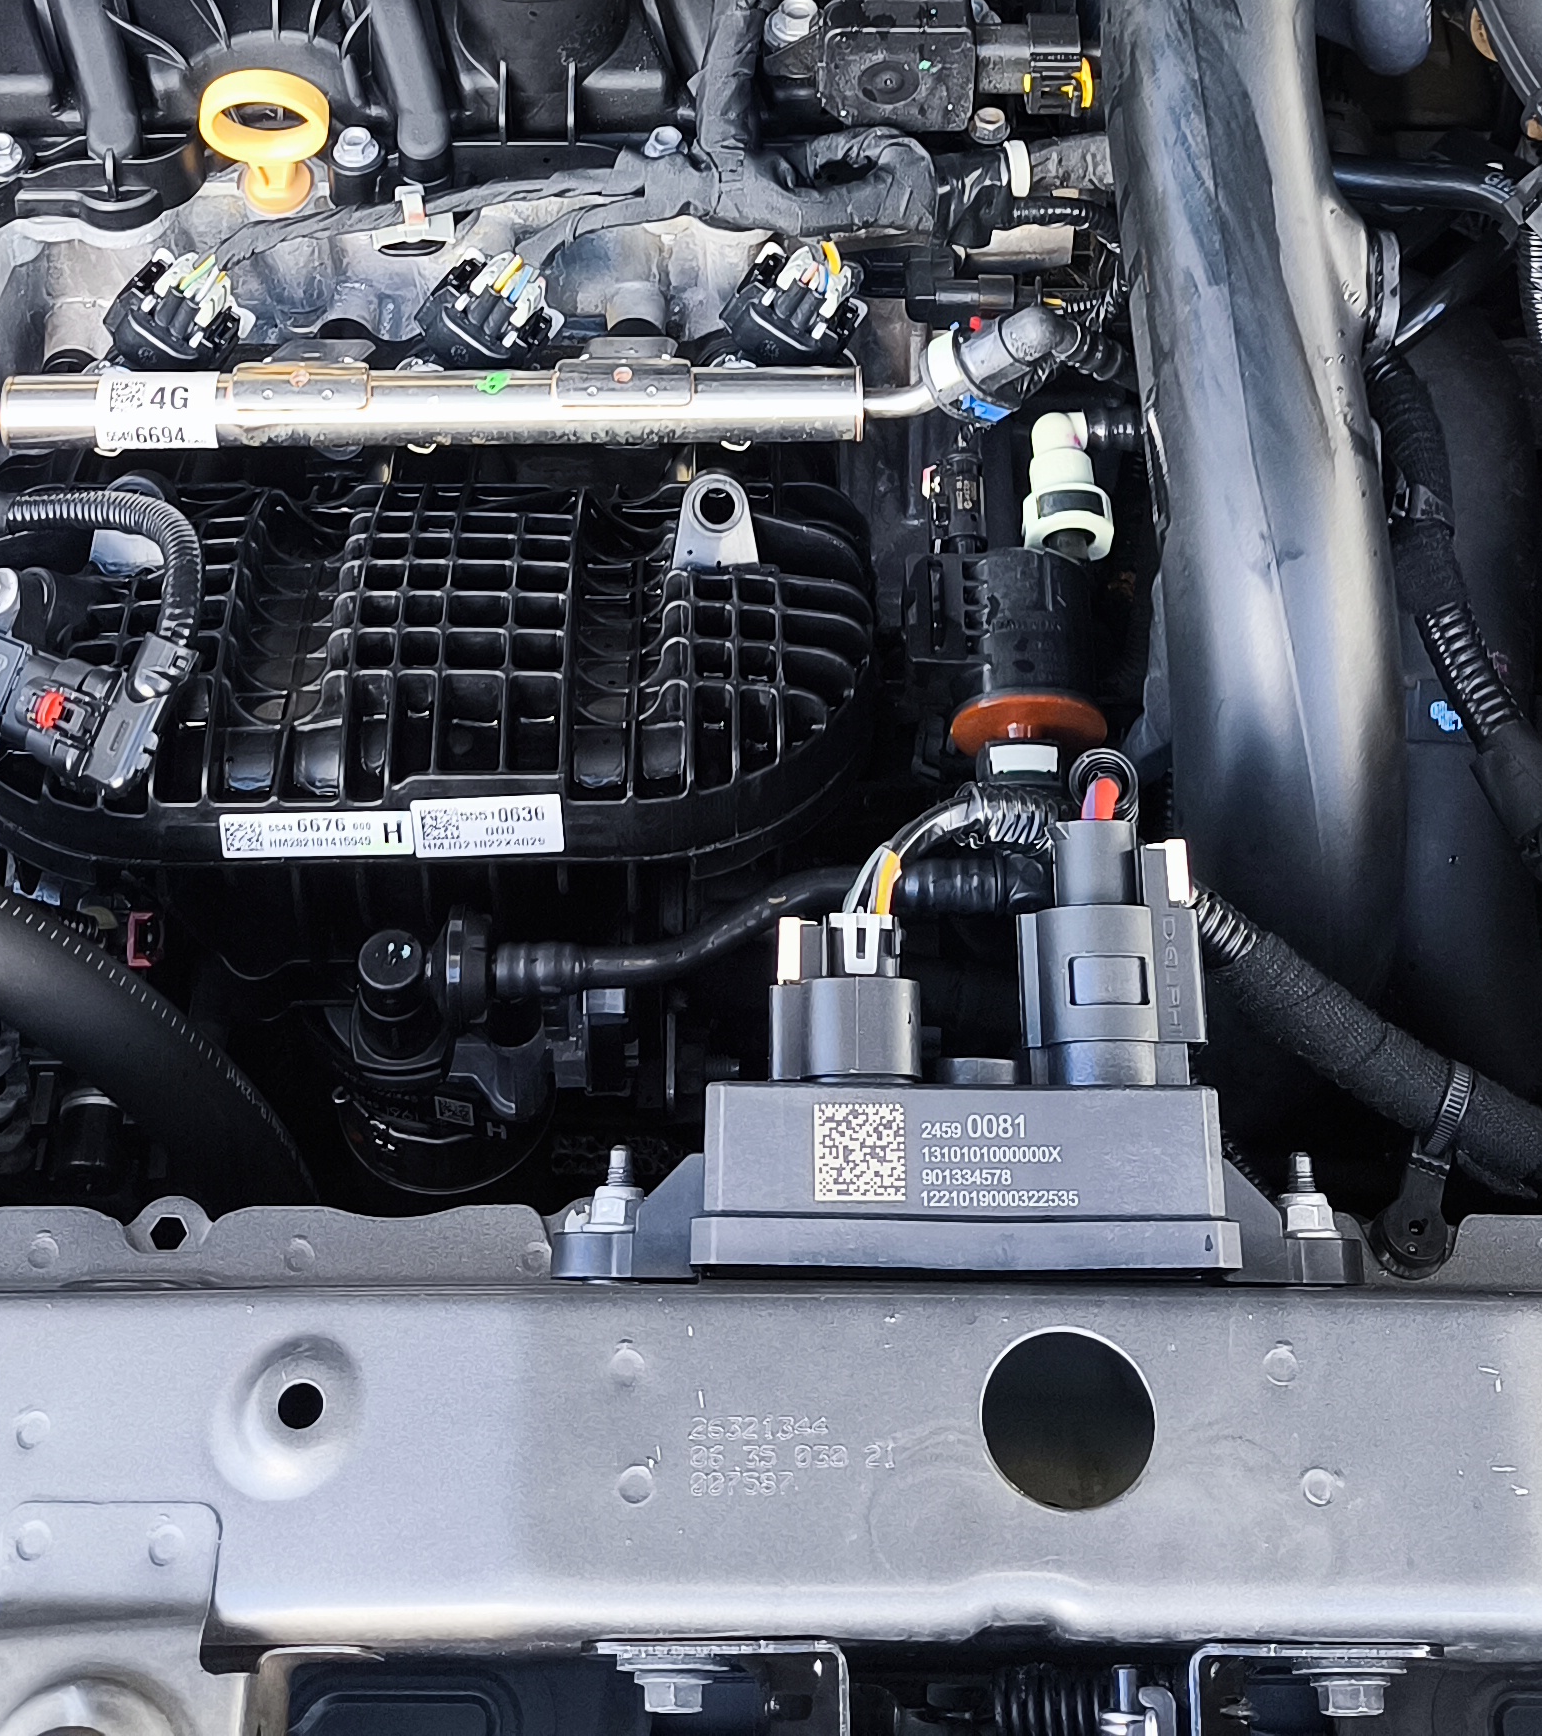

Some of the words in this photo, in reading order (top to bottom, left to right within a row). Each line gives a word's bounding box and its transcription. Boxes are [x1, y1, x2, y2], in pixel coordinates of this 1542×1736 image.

[150, 386, 189, 409] 4G
[297, 818, 346, 832] 6676
[383, 821, 403, 845] H
[921, 1122, 962, 1138] 2459
[967, 1114, 1026, 1138] 0081
[921, 1146, 1062, 1163] 1310101000000X
[922, 1169, 1011, 1185] 901334578
[920, 1190, 1079, 1207] 1221019000322535
[688, 1416, 830, 1441] 26321344
[742, 1444, 778, 1469] 35
[864, 1444, 896, 1469] 21
